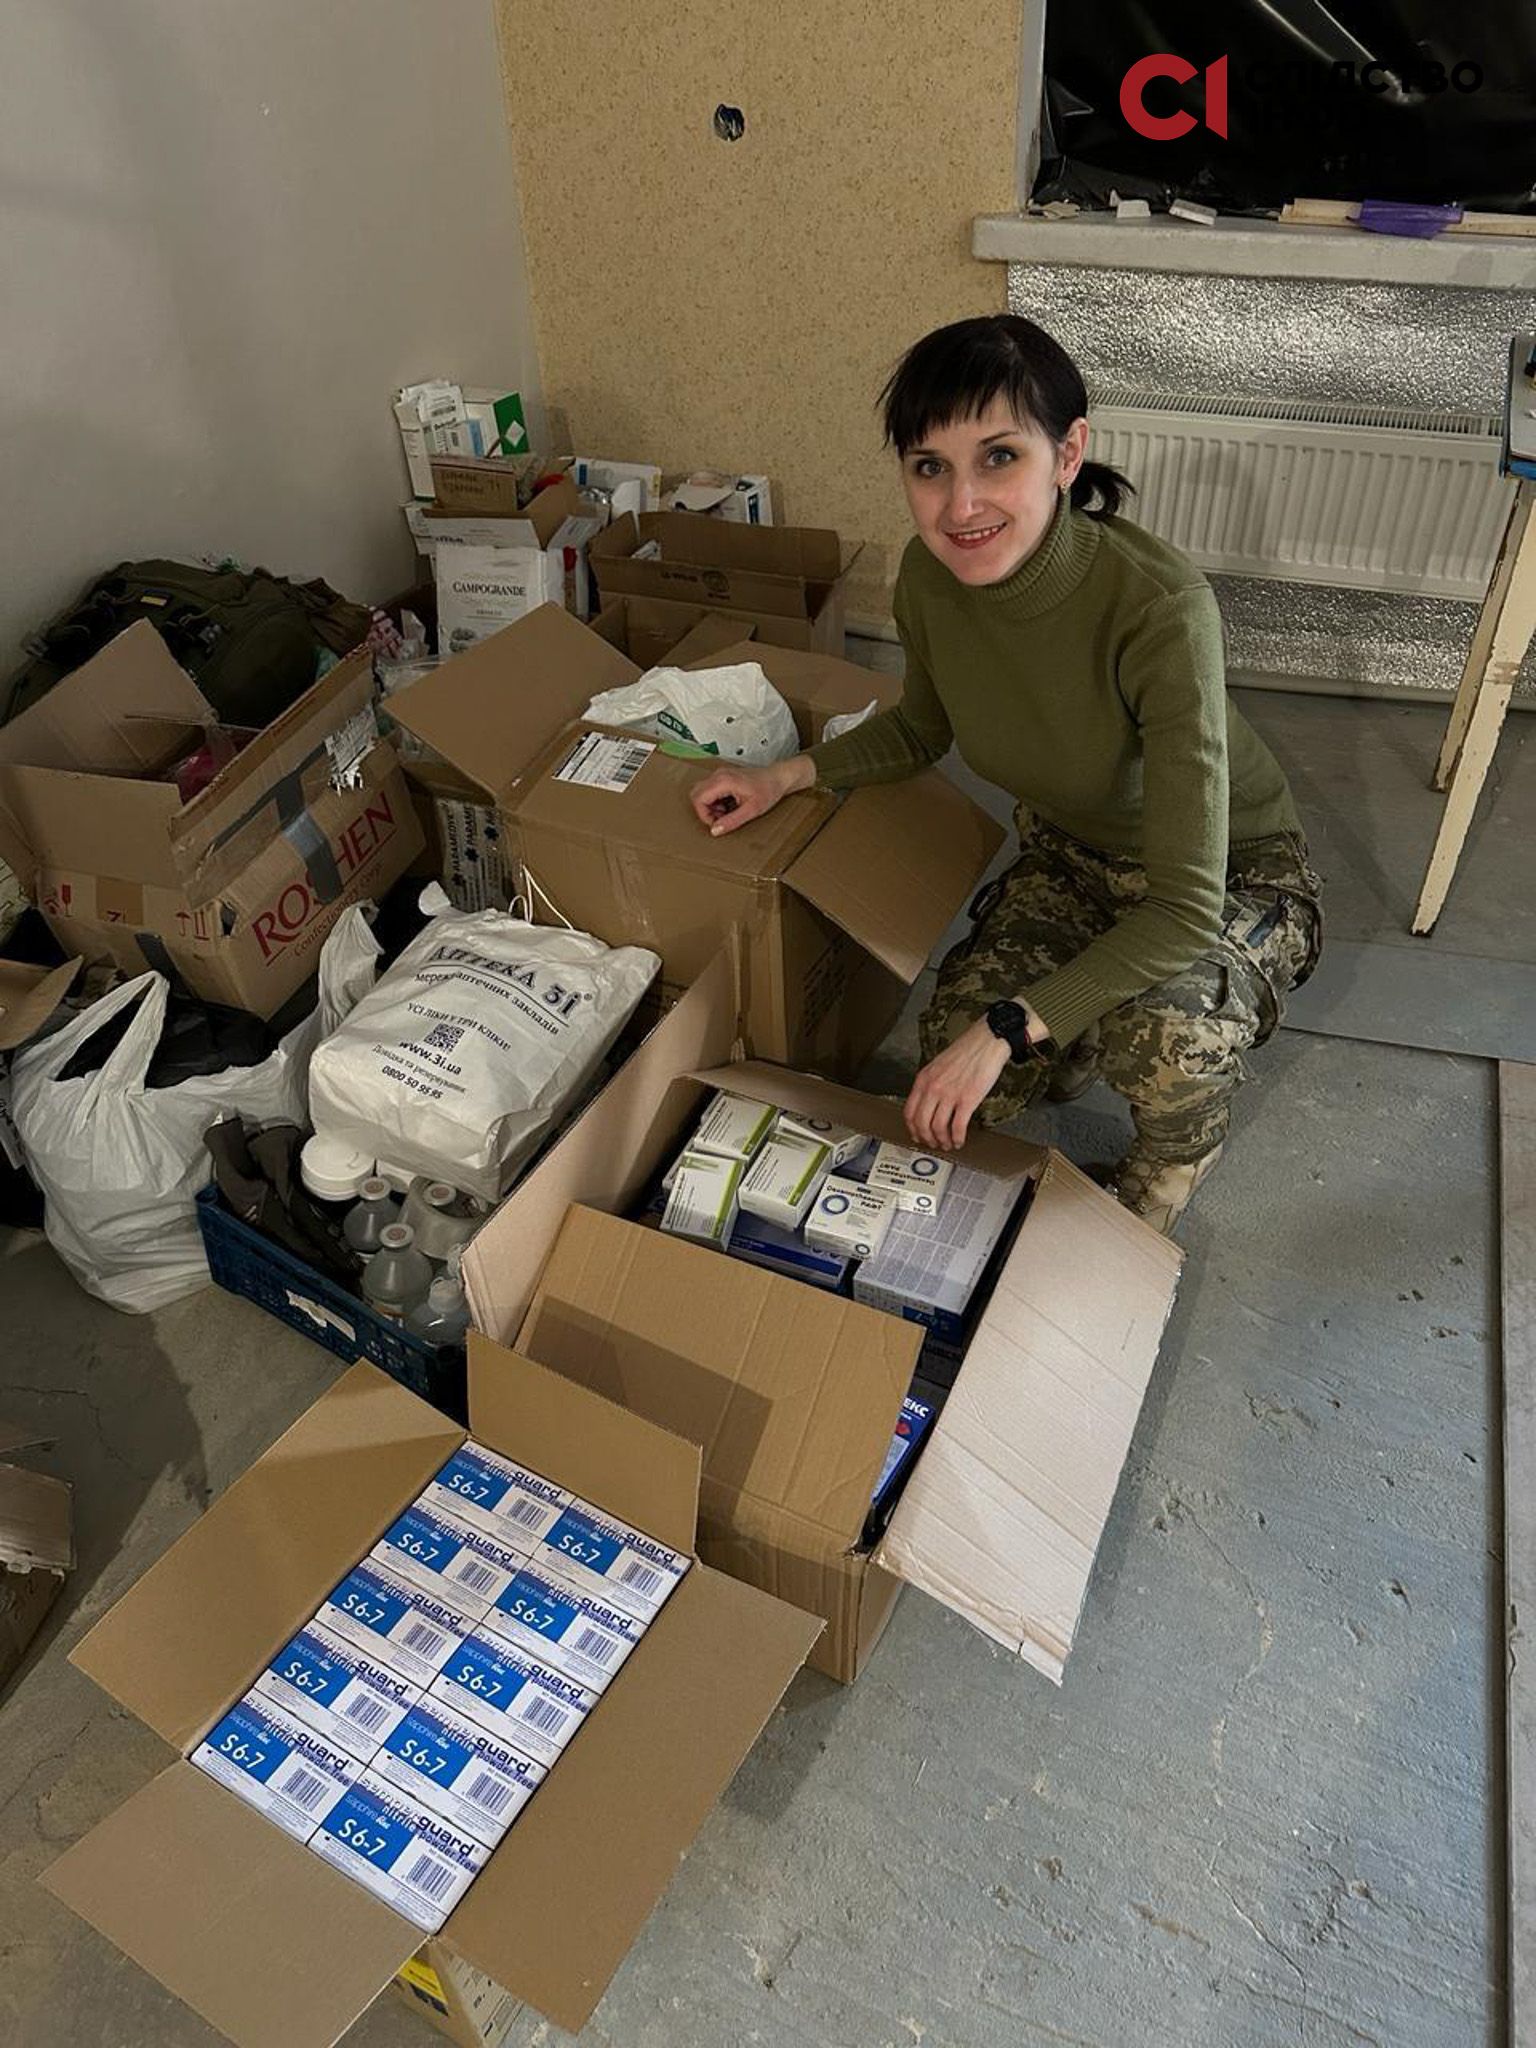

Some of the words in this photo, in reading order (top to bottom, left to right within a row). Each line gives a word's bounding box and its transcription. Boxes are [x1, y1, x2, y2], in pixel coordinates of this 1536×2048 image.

[453, 581, 527, 596] CAMPOGRANDE
[431, 946, 538, 989] АПТЕКА
[457, 1017, 478, 1029] ТРИ
[478, 1024, 511, 1052] КЛІКИ!
[511, 997, 559, 1035] закладів
[399, 1042, 462, 1075] www.3i.ua
[382, 1065, 406, 1081] 0800
[404, 1076, 420, 1088] 50
[417, 1084, 432, 1095] 95
[429, 1089, 444, 1100] 95
[324, 1650, 356, 1674] nitrile
[356, 1672, 390, 1698] powder
[496, 1654, 529, 1678] nitrile
[263, 1721, 295, 1748] nitrile
[295, 1746, 329, 1773] powder
[330, 1767, 351, 1786] free
[441, 1726, 474, 1752] nitrile
[476, 1750, 512, 1777] powder
[513, 1771, 535, 1790] free
[382, 1805, 416, 1833] nitrile
[417, 1830, 454, 1860] powder
[456, 1853, 478, 1874] free
